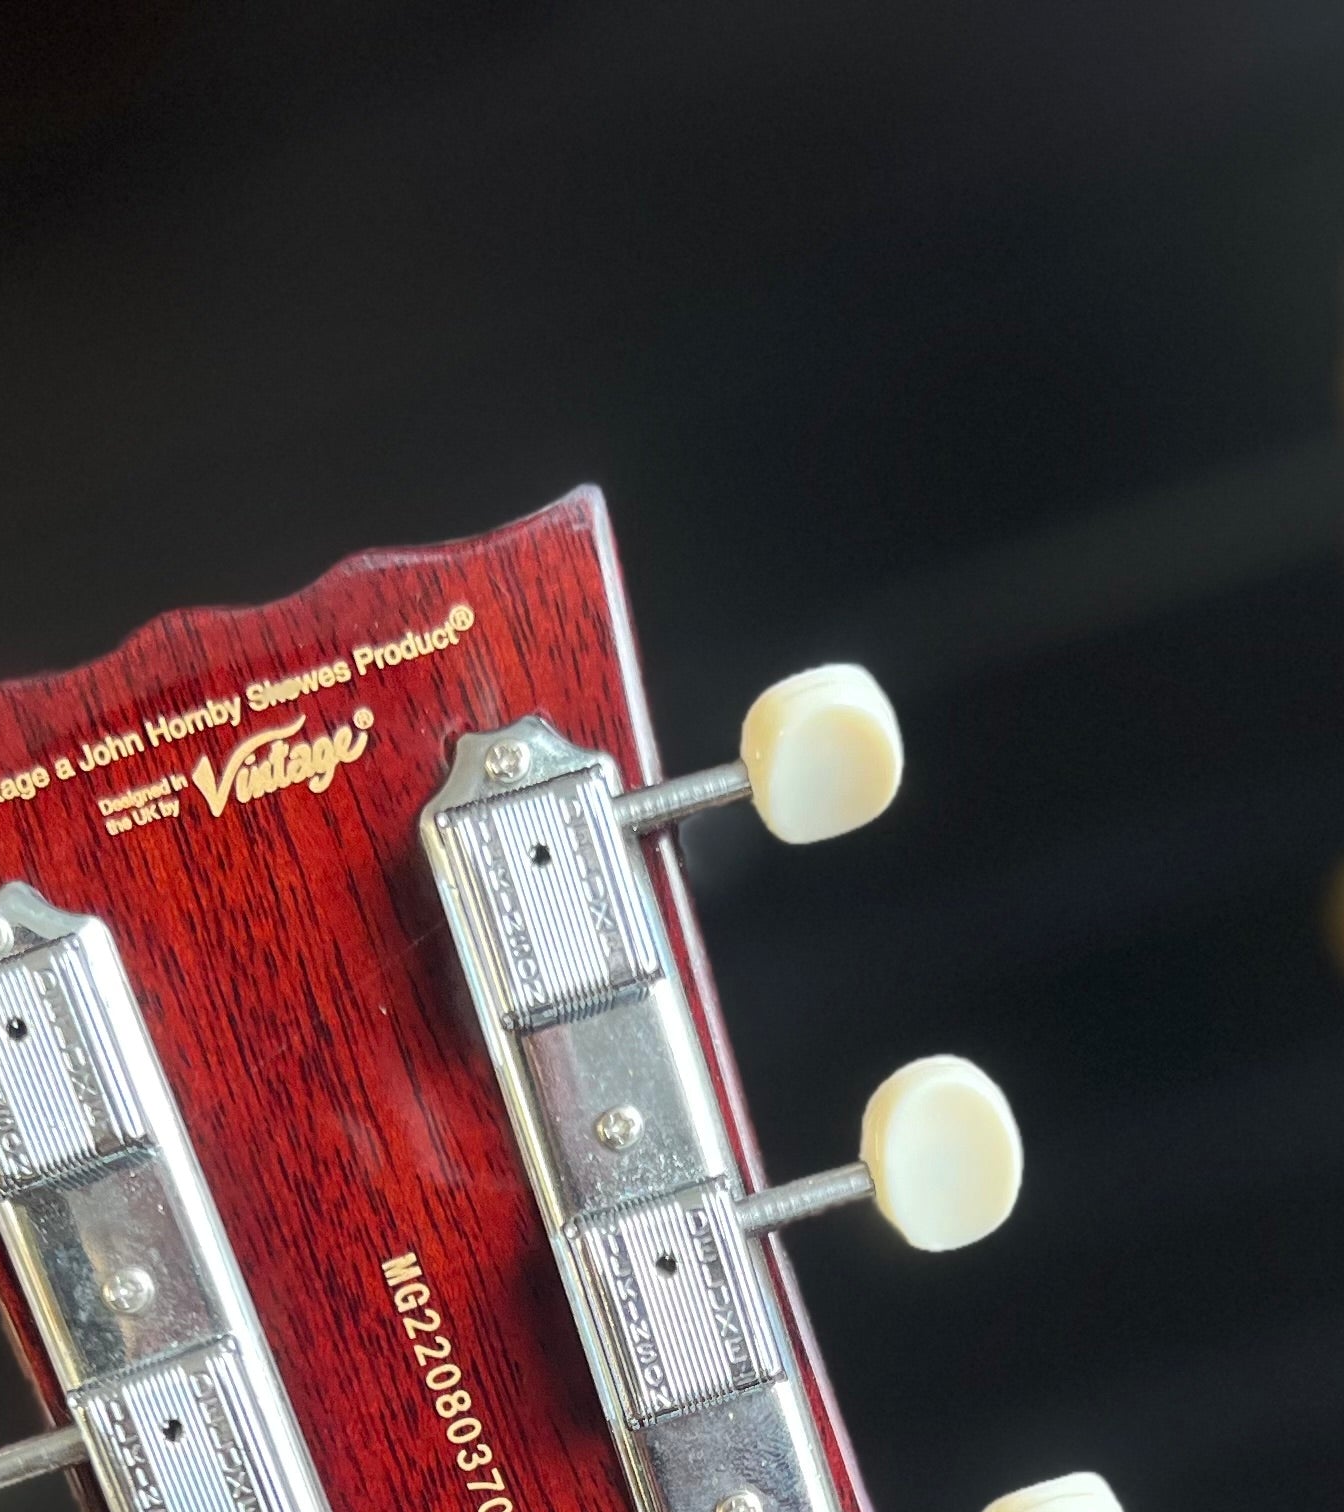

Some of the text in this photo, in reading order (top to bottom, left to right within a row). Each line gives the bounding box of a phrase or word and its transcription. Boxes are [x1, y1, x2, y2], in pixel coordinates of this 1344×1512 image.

[55, 756, 76, 780] a
[78, 732, 145, 772] John
[144, 695, 241, 748] Hornby
[98, 778, 171, 816] Designed
[106, 799, 180, 836] the UK by
